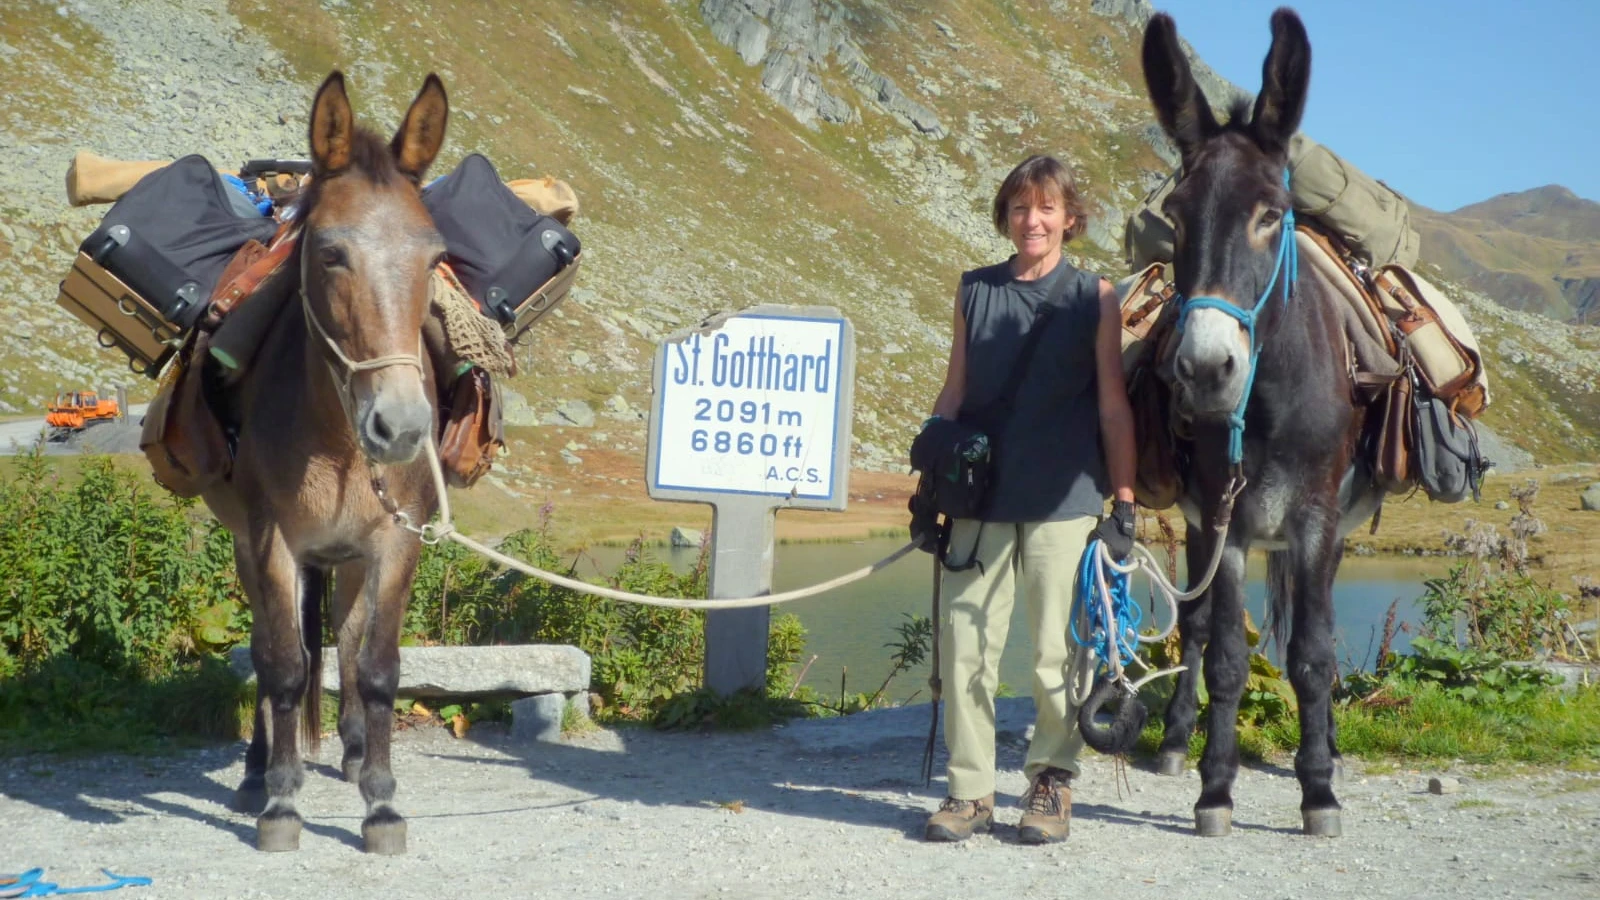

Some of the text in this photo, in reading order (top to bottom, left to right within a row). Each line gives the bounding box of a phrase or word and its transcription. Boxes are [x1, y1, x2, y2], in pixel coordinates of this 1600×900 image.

[674, 333, 831, 393] St. Gotthard
[765, 466, 823, 483] A.C.S.
